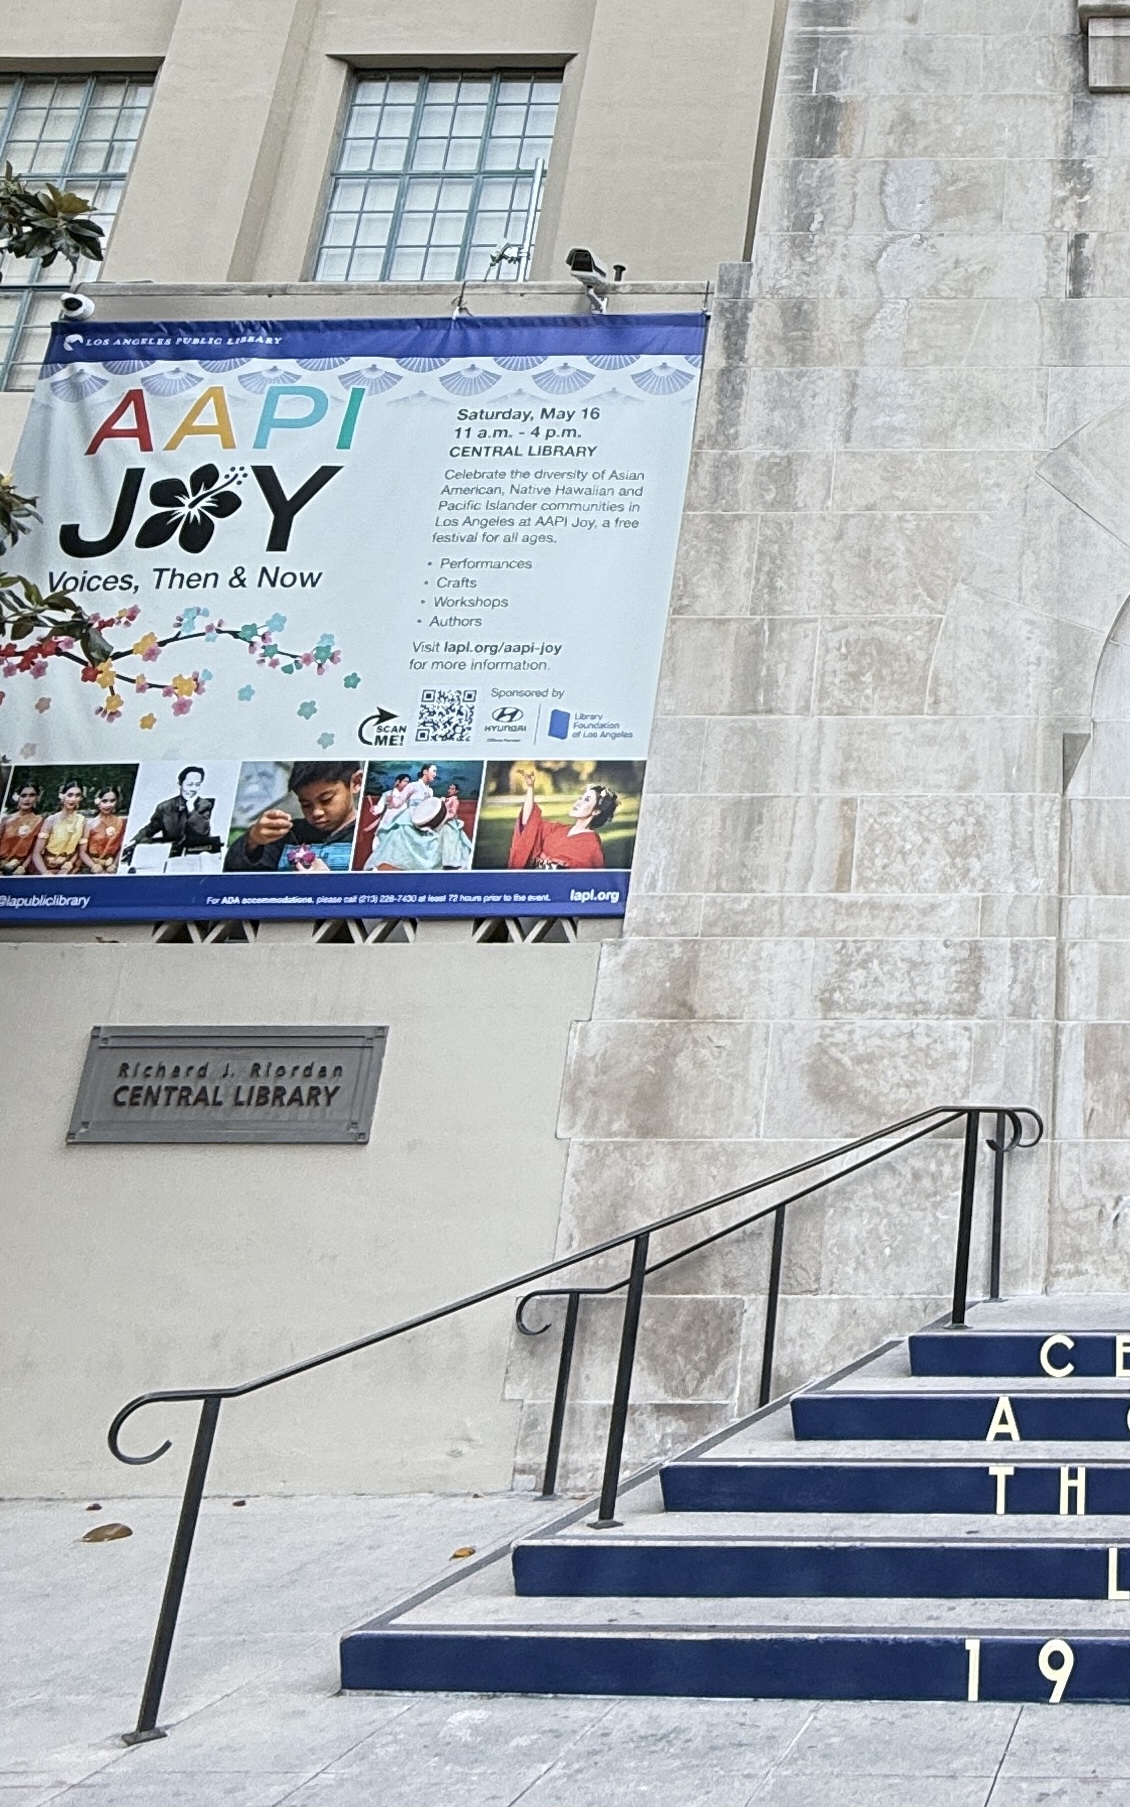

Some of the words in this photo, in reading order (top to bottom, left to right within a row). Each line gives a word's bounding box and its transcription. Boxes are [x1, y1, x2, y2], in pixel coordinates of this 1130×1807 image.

[86, 338, 109, 346] LOS
[113, 337, 171, 346] ANGELES
[175, 337, 222, 345] PUBLIC
[226, 336, 282, 345] LIBRARY
[84, 385, 366, 456] AAPI
[456, 408, 534, 422] Saturday,
[540, 407, 576, 422] May
[581, 407, 601, 420] 16
[454, 427, 472, 439] 11
[477, 428, 513, 439] a.m.
[530, 426, 540, 438] 4
[545, 428, 582, 440] p.m.
[449, 445, 523, 458] CENTRAL
[528, 445, 598, 457] LIBRARY
[445, 469, 506, 480] Celebrate
[510, 469, 531, 479] the
[534, 468, 588, 482] diversity
[592, 469, 606, 480] of
[608, 469, 645, 480] Asian
[440, 484, 505, 496] American,
[509, 484, 551, 495] Native
[555, 485, 614, 496] Hawaiian
[618, 486, 643, 496] and
[438, 500, 482, 511] Pacific
[486, 500, 538, 511] Islander
[541, 501, 624, 512] communities
[629, 502, 640, 512] in
[435, 516, 459, 526] Los
[462, 516, 515, 529] Angeles
[518, 517, 531, 526] at
[535, 516, 567, 527] AAPI
[571, 517, 598, 530] Joy,
[602, 519, 610, 528] a
[615, 517, 639, 528] free
[432, 532, 478, 542] festival
[482, 532, 500, 542] for
[503, 532, 518, 542] all
[521, 534, 557, 545] ages.
[440, 557, 533, 569] Performances
[49, 570, 140, 593] Voices,
[153, 568, 219, 589] Then
[228, 566, 247, 588] &
[257, 566, 323, 588] Now
[437, 576, 477, 588] Crafts
[434, 596, 509, 609] Workshops
[429, 616, 483, 627] Authors
[412, 641, 440, 653] Visit
[444, 641, 563, 656] lapl.org/aapi-joy
[409, 659, 428, 670] for
[431, 660, 467, 671] more
[470, 658, 551, 671] information.
[491, 688, 549, 699] Sponsored
[551, 688, 565, 699] by
[575, 712, 603, 720] Library
[376, 724, 407, 733] SCAN
[373, 734, 405, 746] ME!
[600, 731, 633, 740] Angeles
[221, 896, 240, 904] ADA
[569, 889, 620, 904] lapl.org
[117, 1062, 209, 1078] Richard
[222, 1062, 234, 1078] J.
[250, 1062, 343, 1078] Riordan
[113, 1085, 224, 1107] CENTRAL
[234, 1085, 340, 1107] LIBRARY
[985, 1396, 1020, 1442] A
